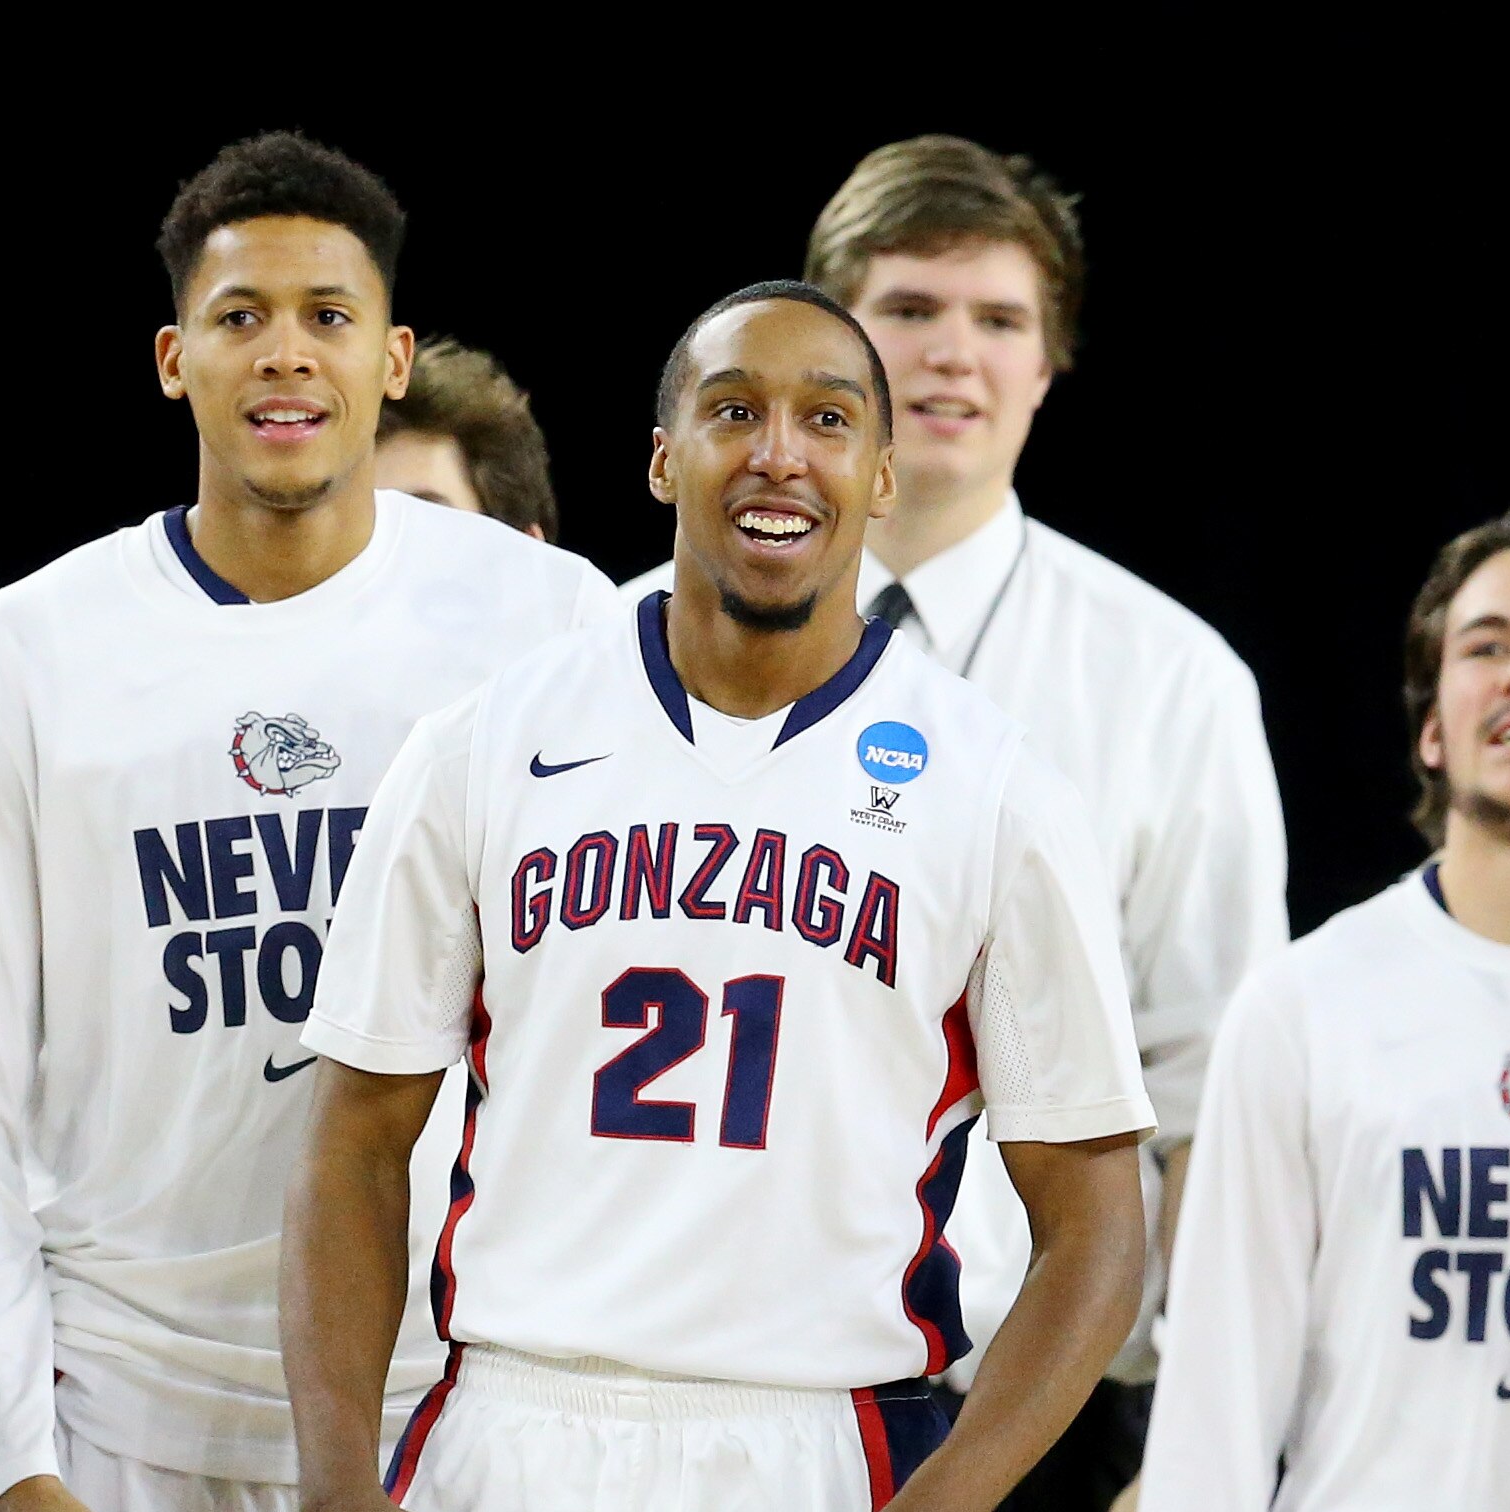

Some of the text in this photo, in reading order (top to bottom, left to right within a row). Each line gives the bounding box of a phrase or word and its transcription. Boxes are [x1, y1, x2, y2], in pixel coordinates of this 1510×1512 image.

[864, 745, 924, 771] NCAA
[133, 806, 370, 928] NEVE
[850, 808, 907, 829] WEST COAST
[510, 821, 900, 990] GONZAGA
[163, 919, 332, 1034] STO
[590, 966, 786, 1150] 21
